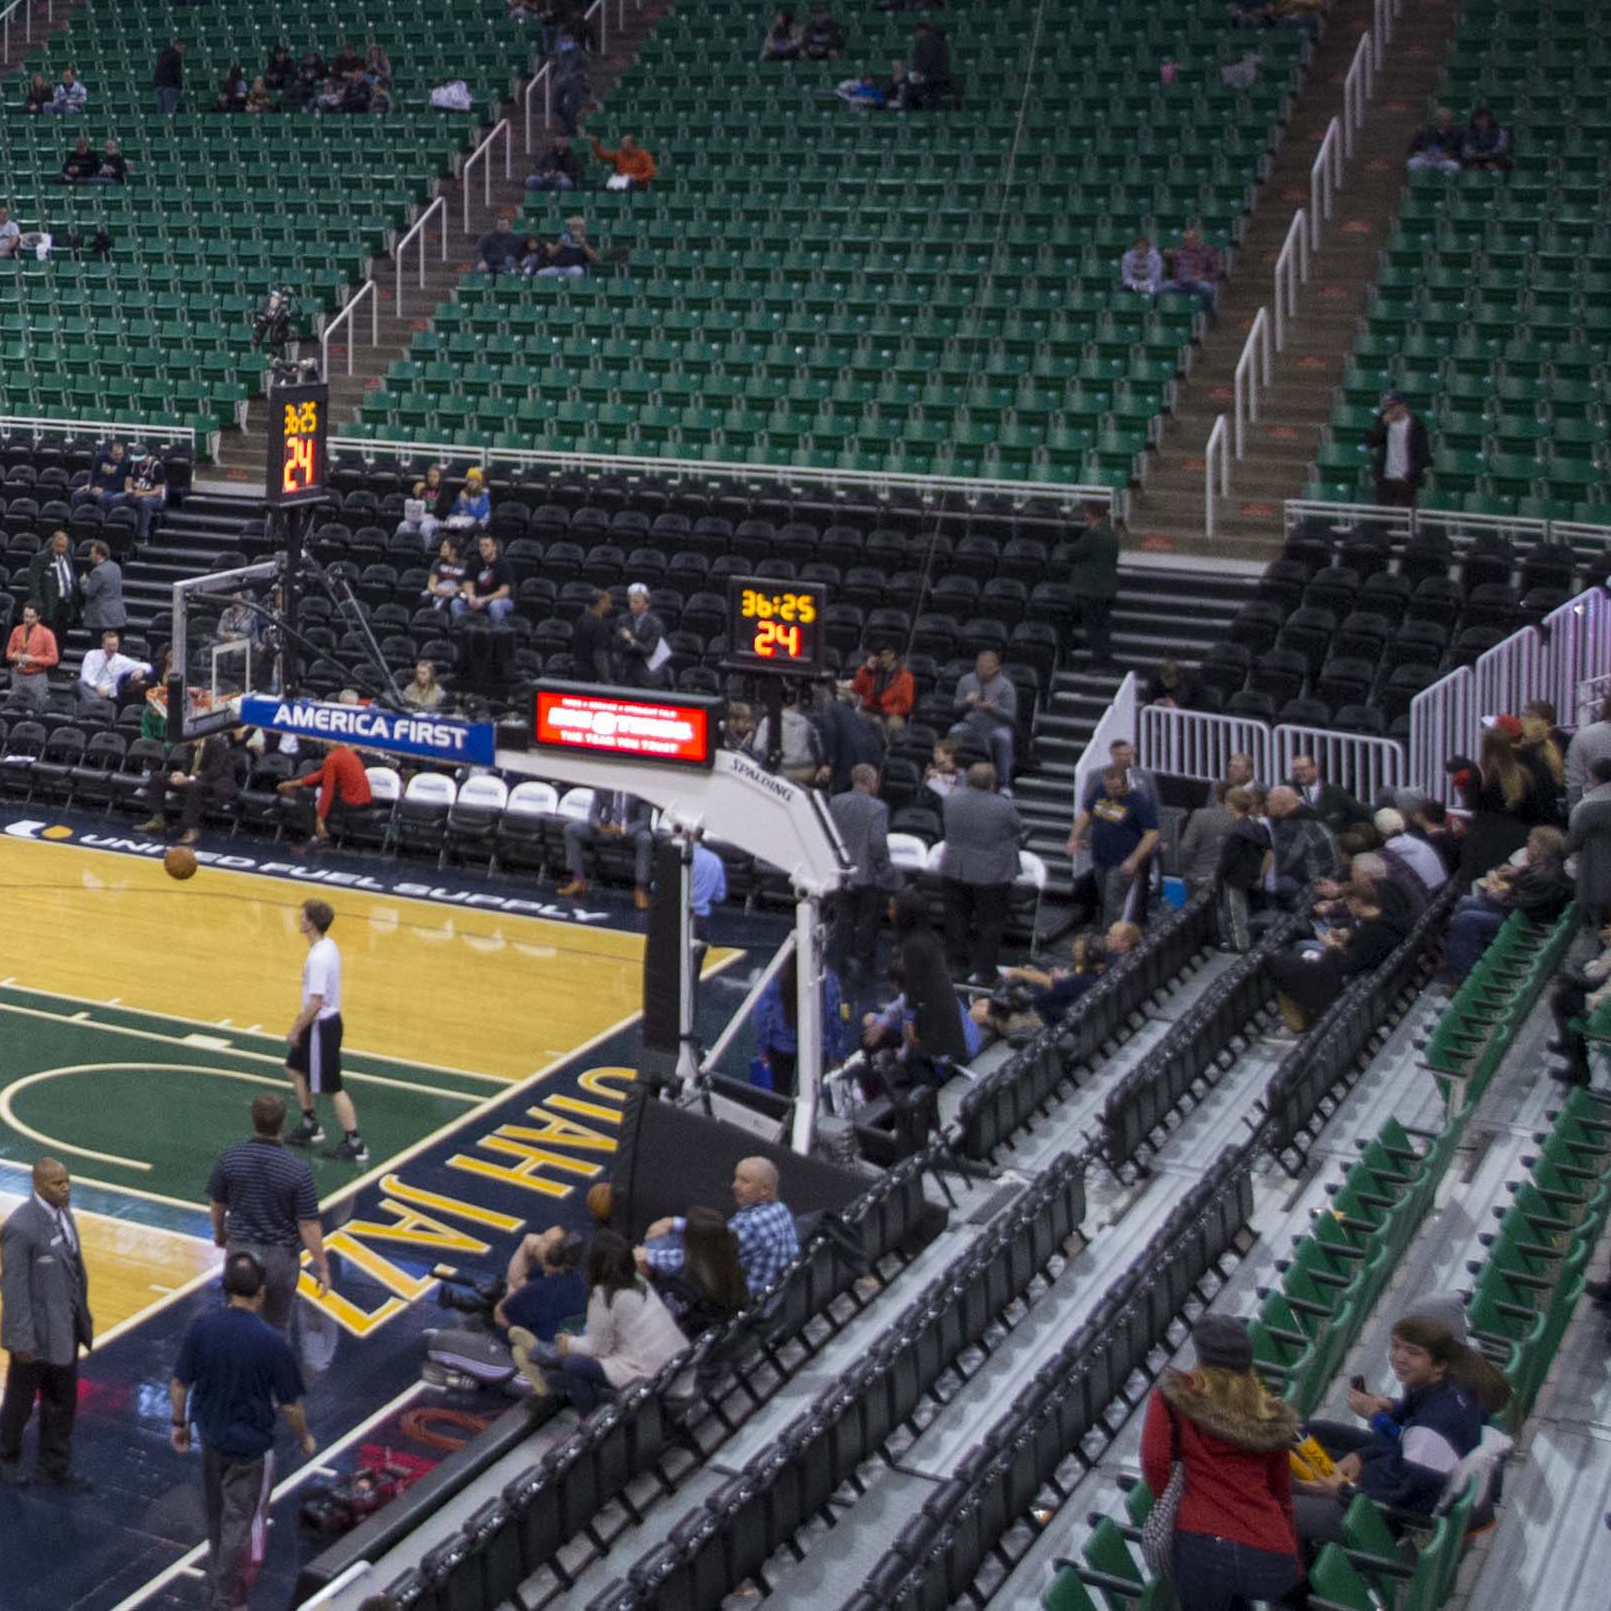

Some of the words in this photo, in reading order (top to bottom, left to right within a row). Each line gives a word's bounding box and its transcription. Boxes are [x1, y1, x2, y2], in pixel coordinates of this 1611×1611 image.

[283, 400, 318, 436] 36:25
[282, 436, 315, 494] 24
[741, 589, 817, 624] 36:25
[753, 619, 802, 659] 24
[272, 704, 390, 740] AMERICA
[393, 718, 469, 750] FIRST
[729, 757, 794, 803] SPALDING
[78, 833, 257, 869] UNIED
[256, 860, 386, 894] FUEL
[392, 882, 610, 924] SUPPLY
[445, 1064, 640, 1201] UTAH
